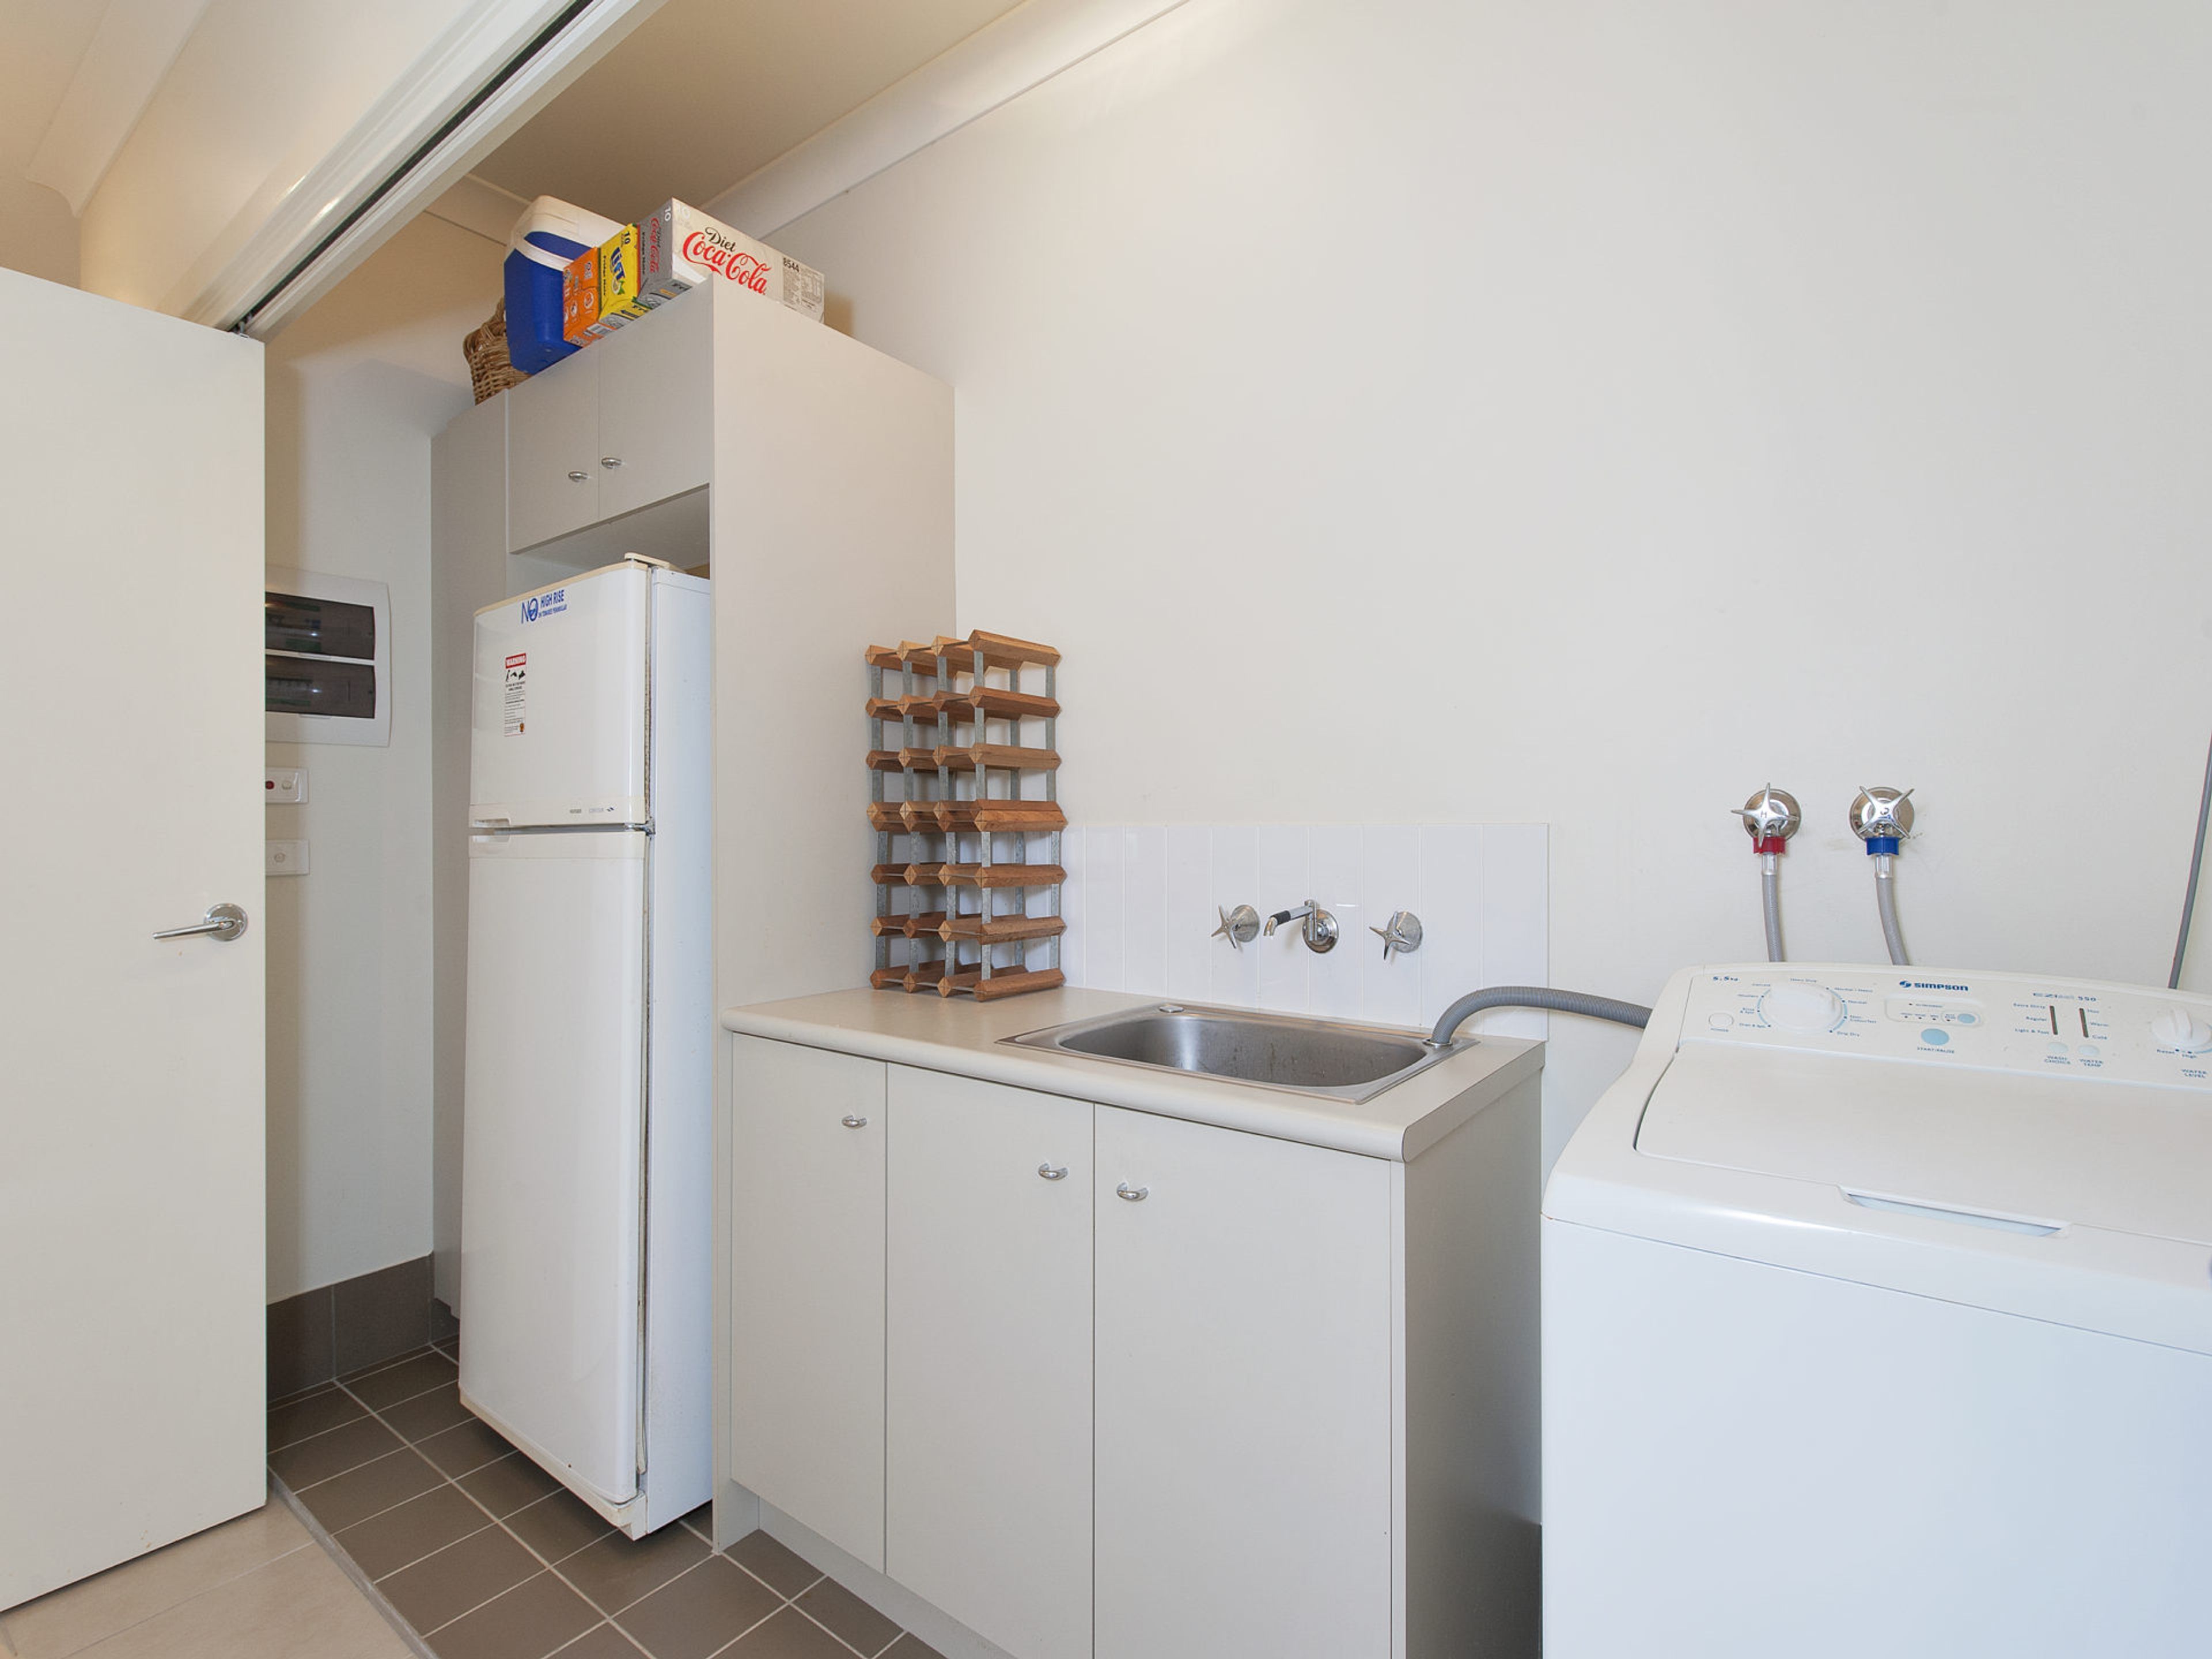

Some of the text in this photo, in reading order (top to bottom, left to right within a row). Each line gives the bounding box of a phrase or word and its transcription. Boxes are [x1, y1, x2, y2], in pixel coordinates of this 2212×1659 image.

[665, 207, 671, 221] 10
[624, 231, 631, 244] 10
[704, 226, 736, 252] Diet
[682, 232, 772, 295] Coca-Cola
[540, 593, 552, 608] HIGH
[553, 589, 565, 604] RISE
